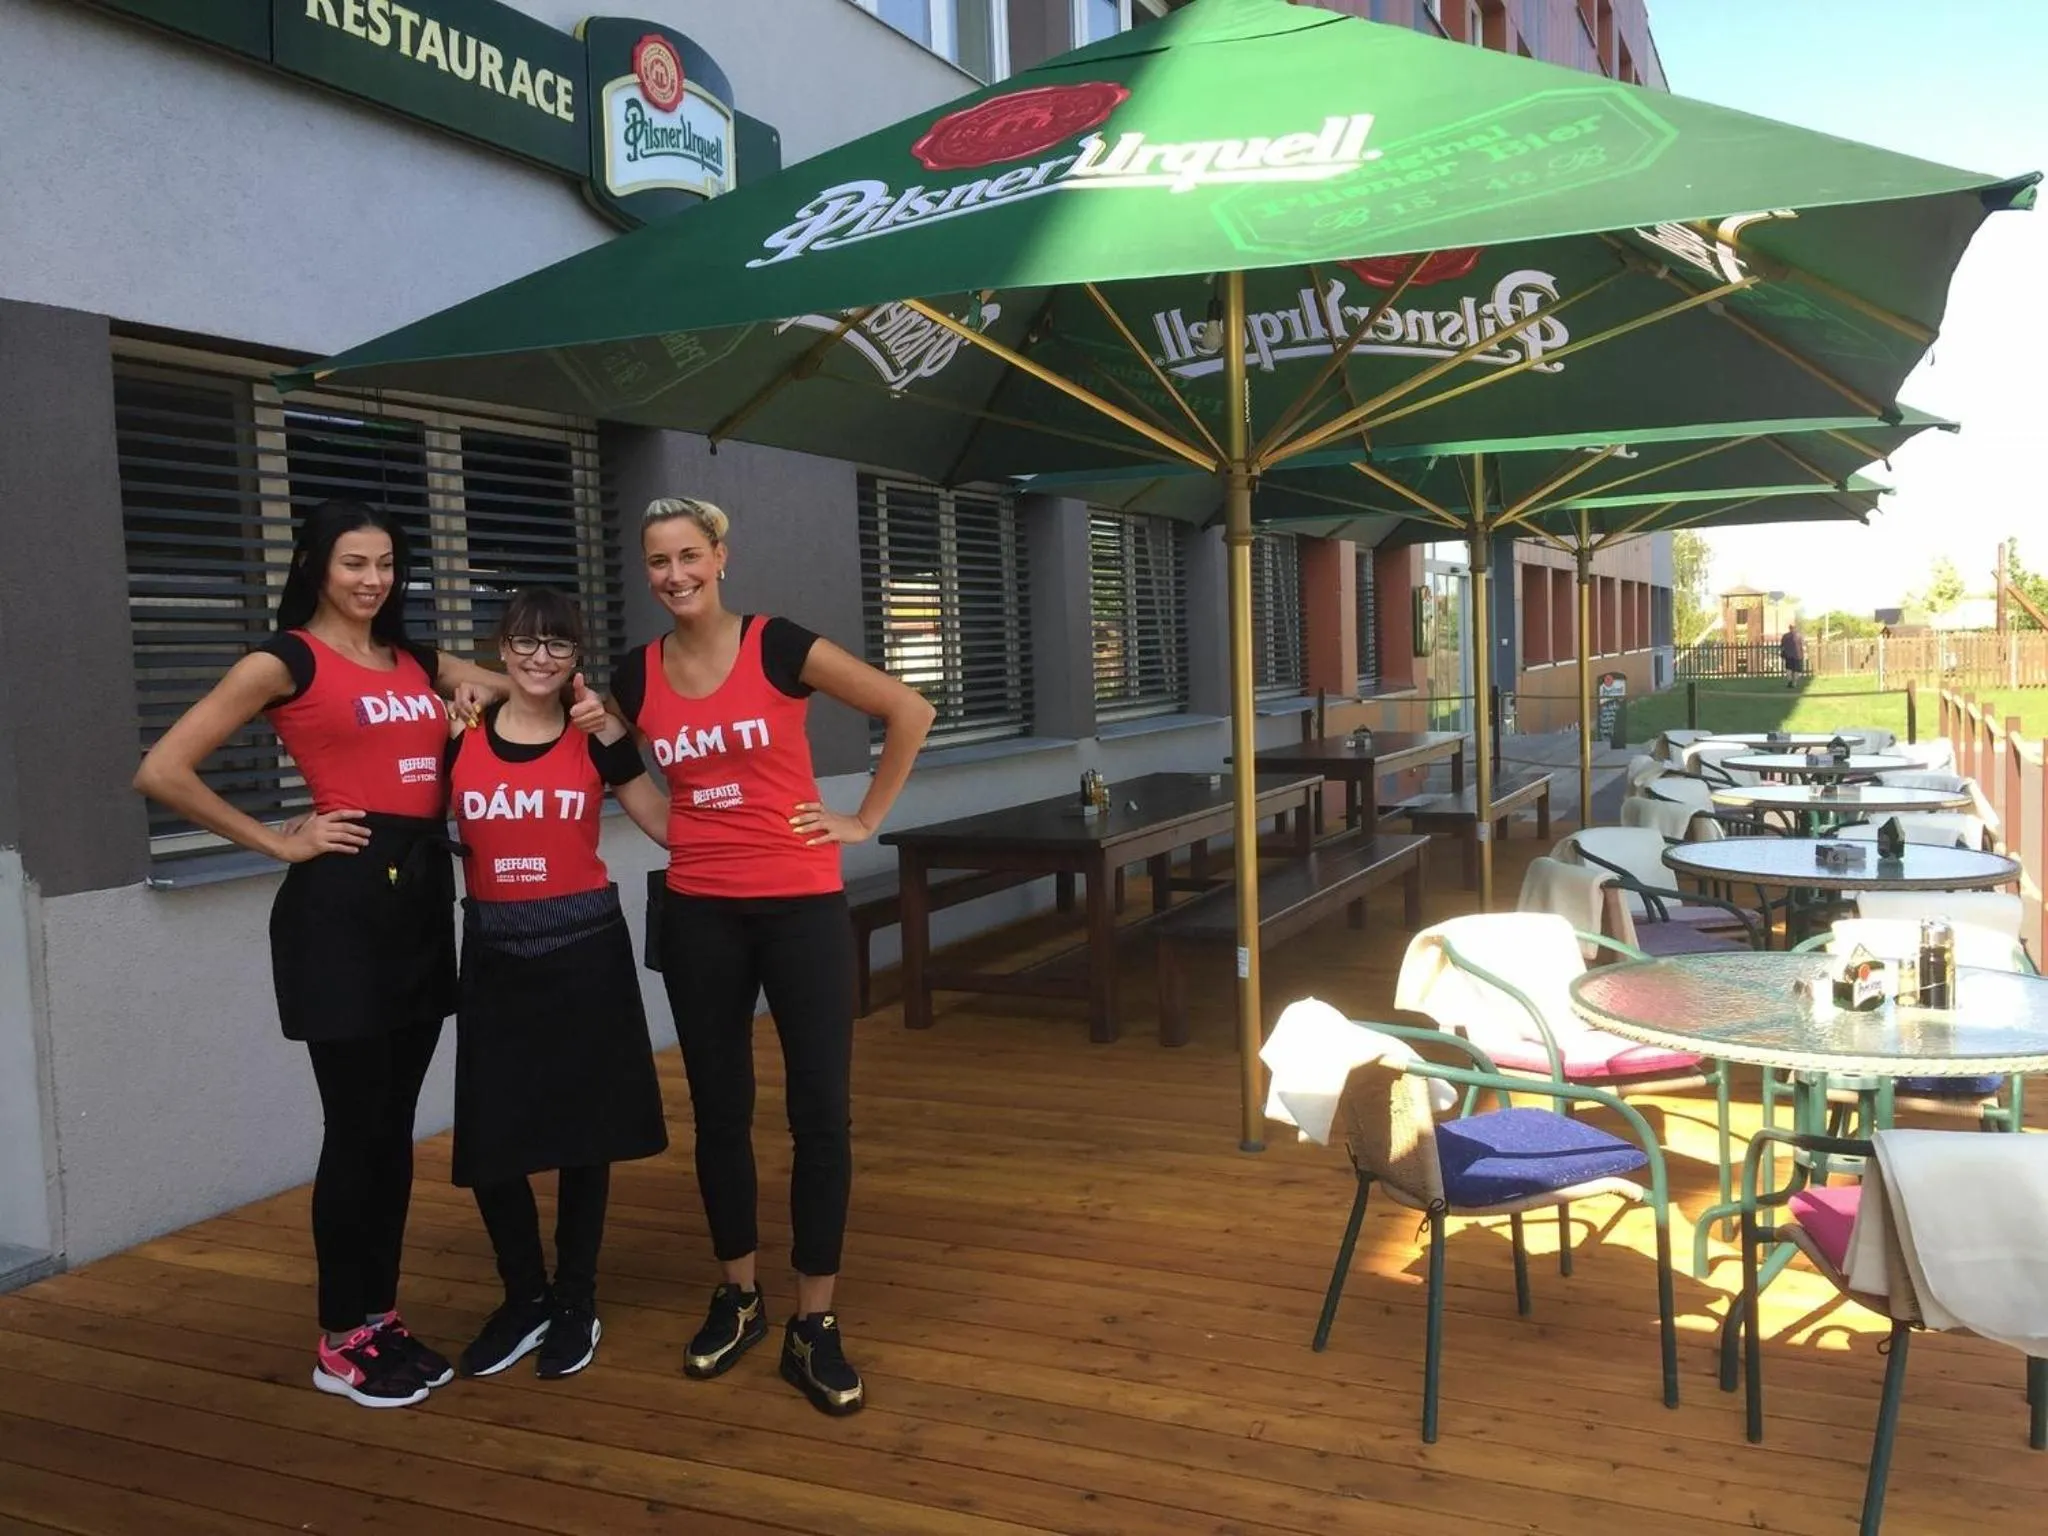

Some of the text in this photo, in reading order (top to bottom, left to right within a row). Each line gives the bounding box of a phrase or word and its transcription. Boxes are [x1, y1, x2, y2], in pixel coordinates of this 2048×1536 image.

[624, 97, 723, 172] Pilsner Urquell
[745, 153, 1080, 269] Pilsner
[1066, 113, 1375, 194] Urquell
[361, 690, 437, 724] DÁM
[653, 718, 770, 767] DÁM TI
[398, 757, 437, 774] BEEFEATER
[463, 783, 544, 820] DÁM
[554, 789, 585, 820] TI
[693, 783, 743, 805] BEEFEATER
[716, 797, 744, 808] TONIC
[494, 857, 547, 873] BEEFEATER
[520, 873, 547, 882] TONIC
